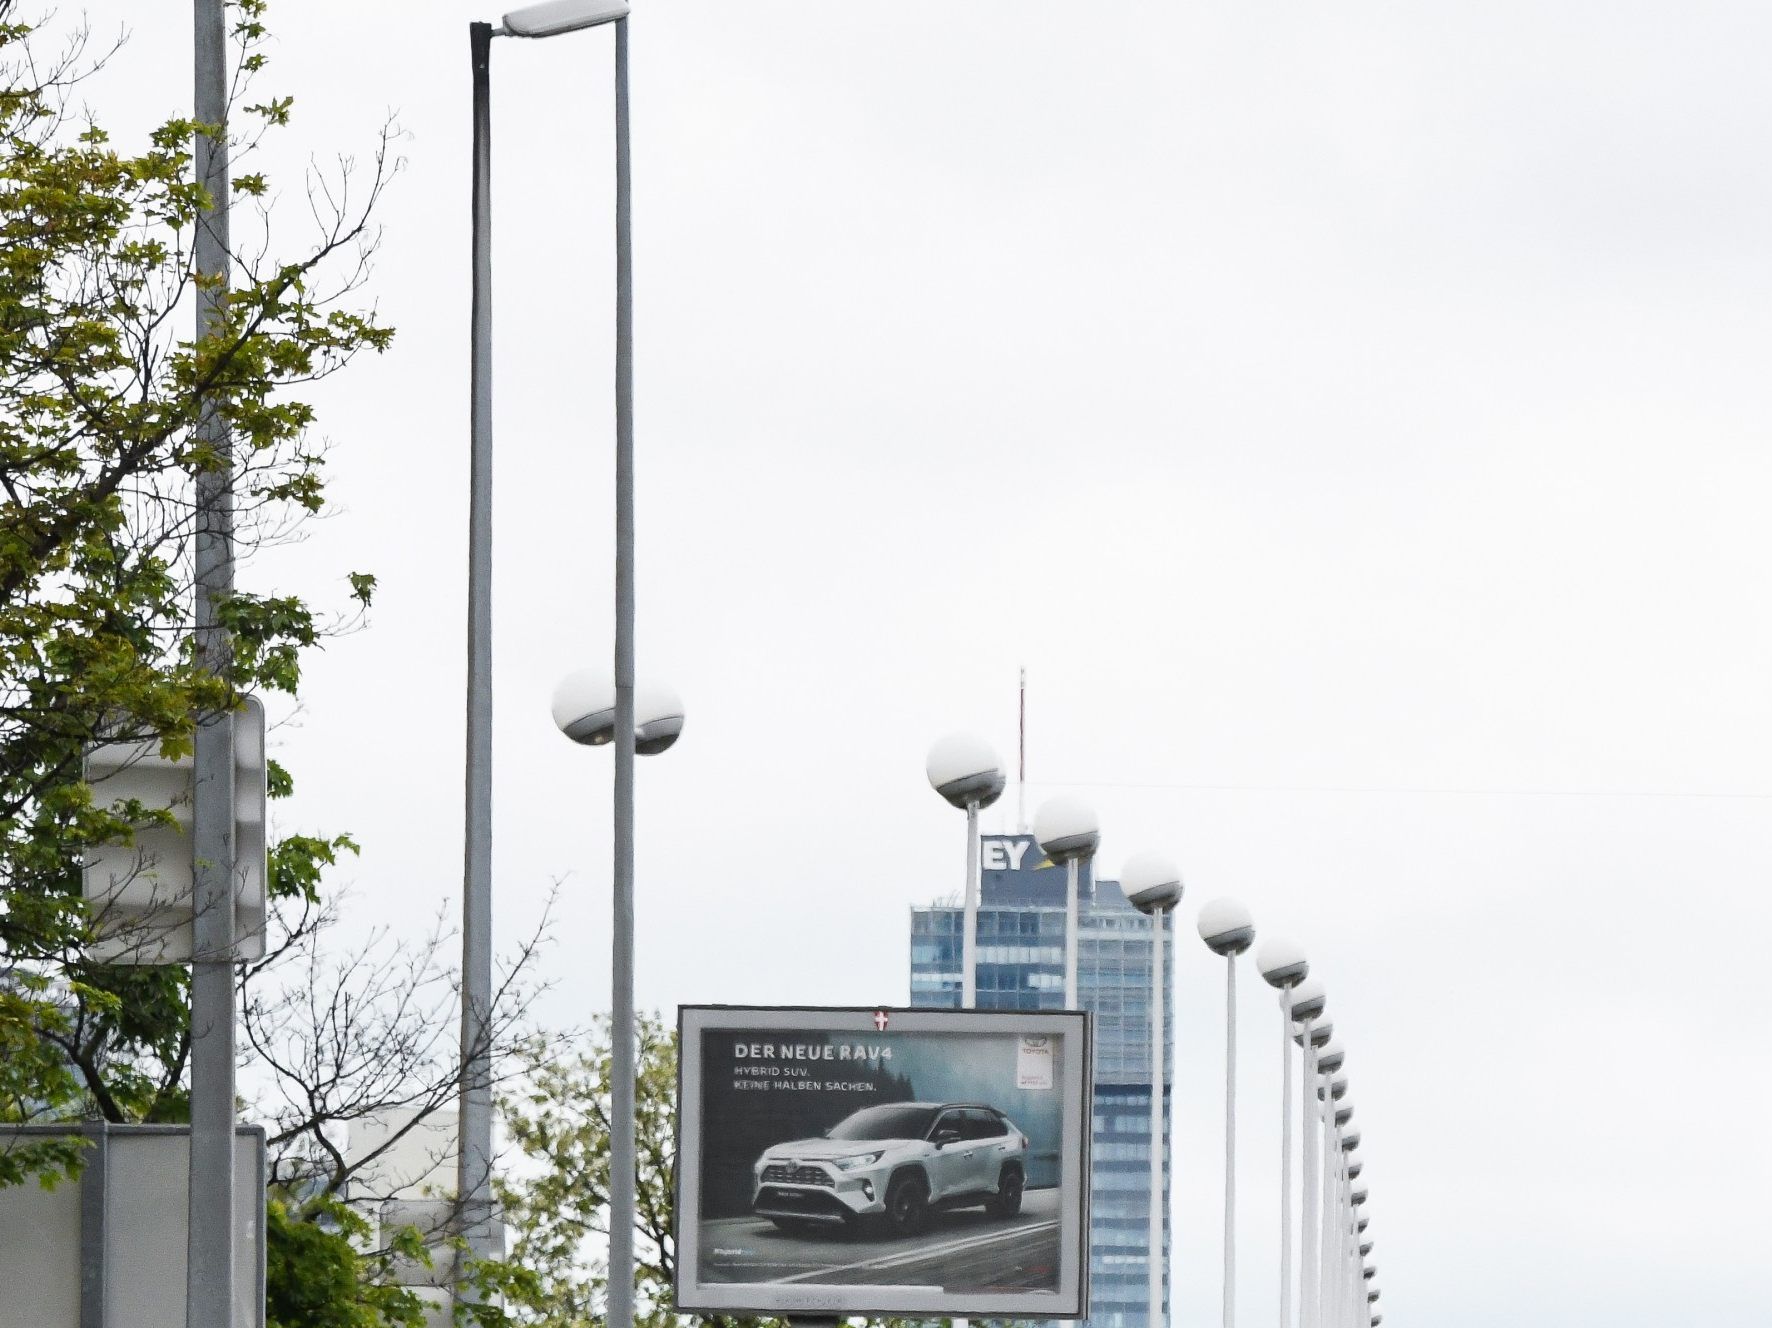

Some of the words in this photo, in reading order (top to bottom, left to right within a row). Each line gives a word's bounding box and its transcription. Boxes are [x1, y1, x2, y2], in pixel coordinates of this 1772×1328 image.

[982, 839, 1031, 871] EY
[734, 1043, 776, 1059] DER
[781, 1044, 834, 1060] NEUE
[839, 1045, 893, 1061] RAV4
[733, 1066, 780, 1077] HYBRID
[783, 1067, 811, 1077] SUV.
[733, 1080, 771, 1091] KEINE
[773, 1081, 822, 1091] HALBEN
[825, 1081, 877, 1092] SACHEN.
